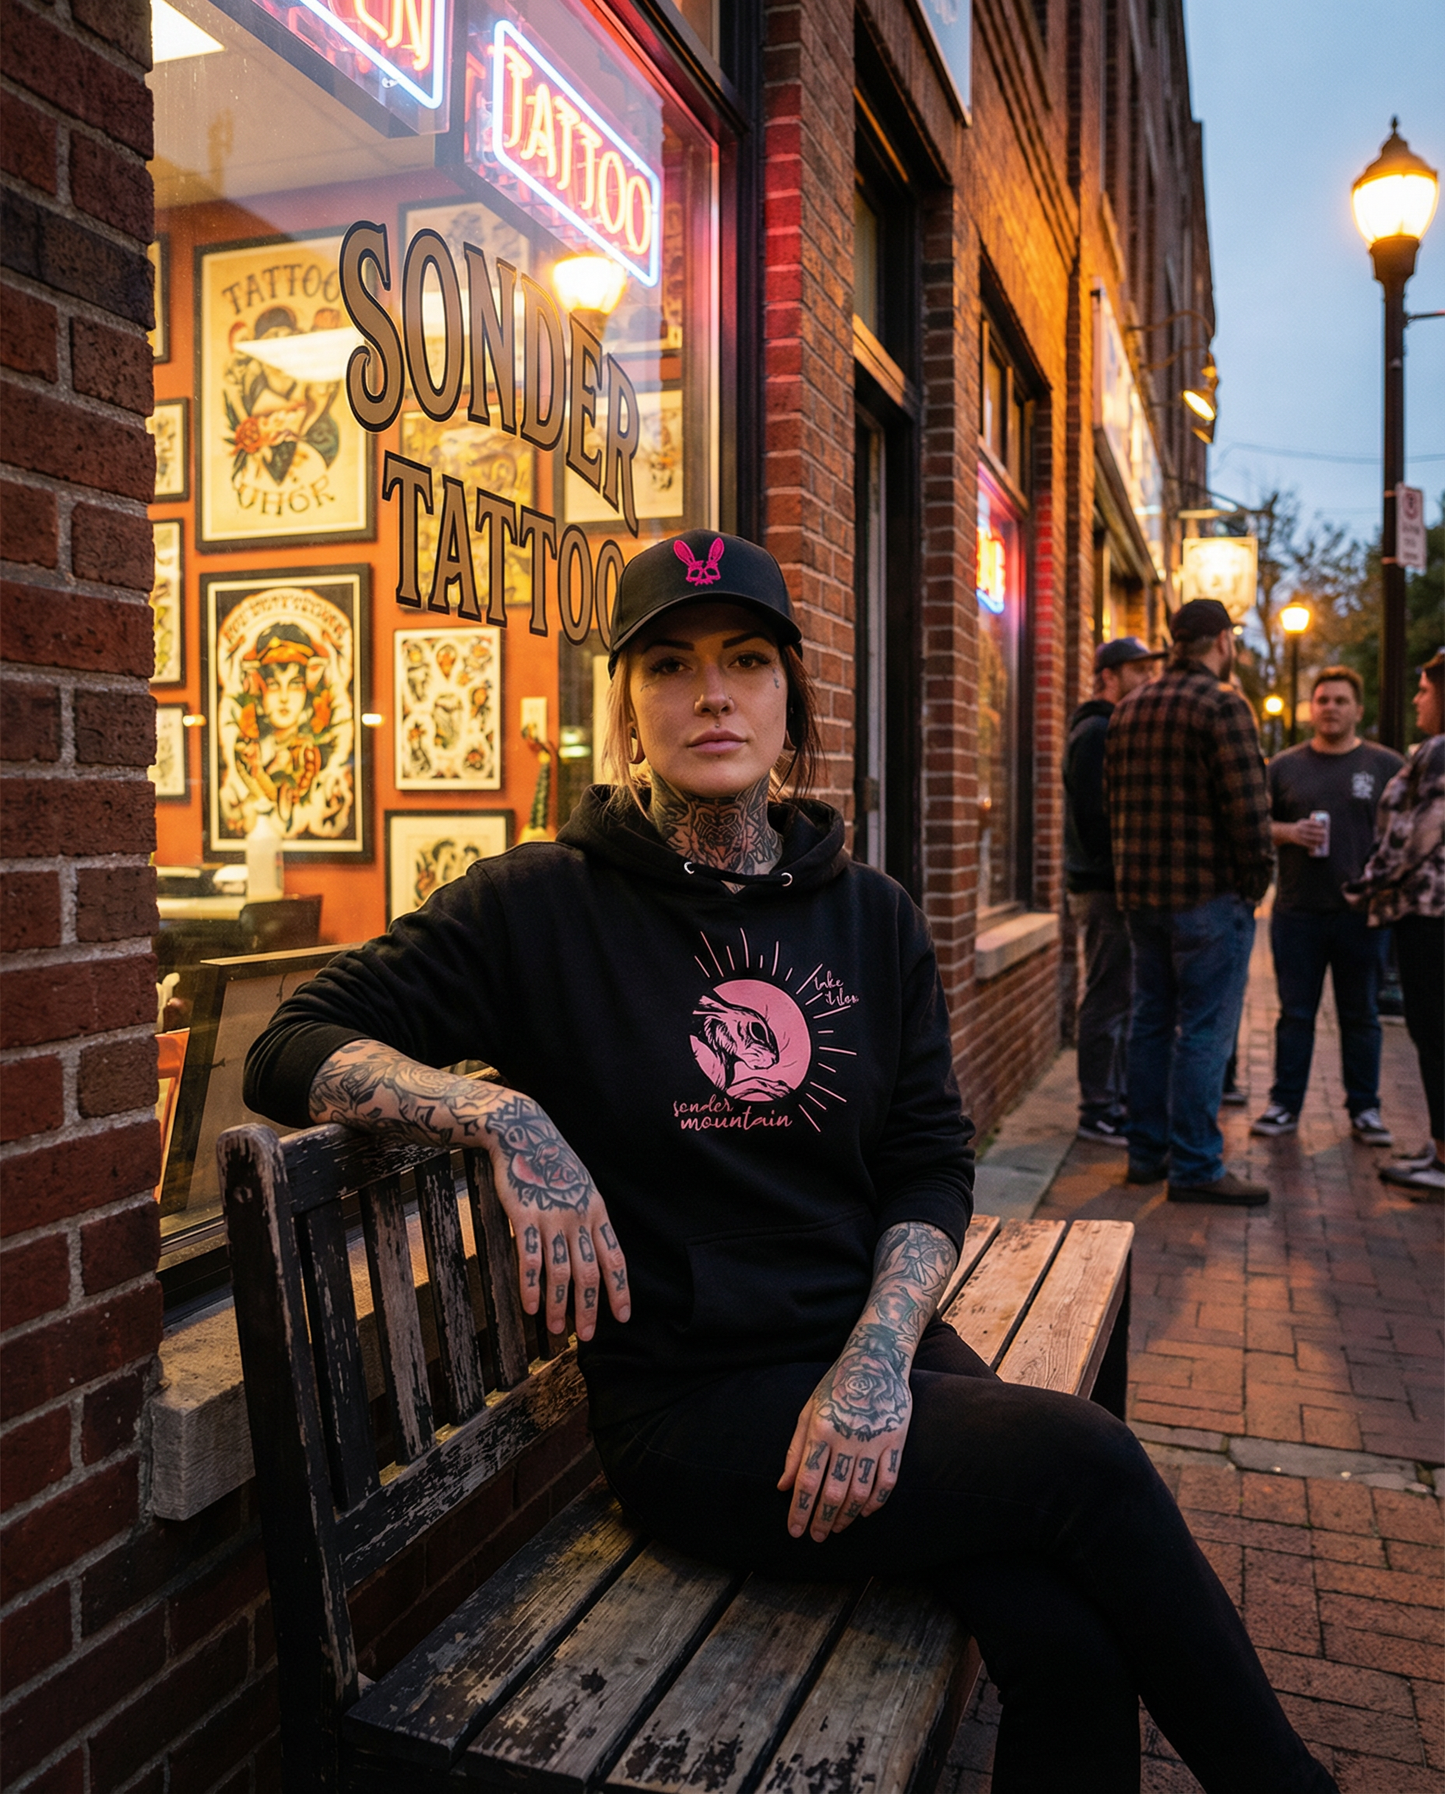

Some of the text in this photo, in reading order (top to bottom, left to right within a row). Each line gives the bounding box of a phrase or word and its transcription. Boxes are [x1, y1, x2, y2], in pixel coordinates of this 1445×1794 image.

[488, 45, 651, 255] TATTOO
[339, 220, 640, 538] SONDER
[680, 1105, 793, 1131] mountain
